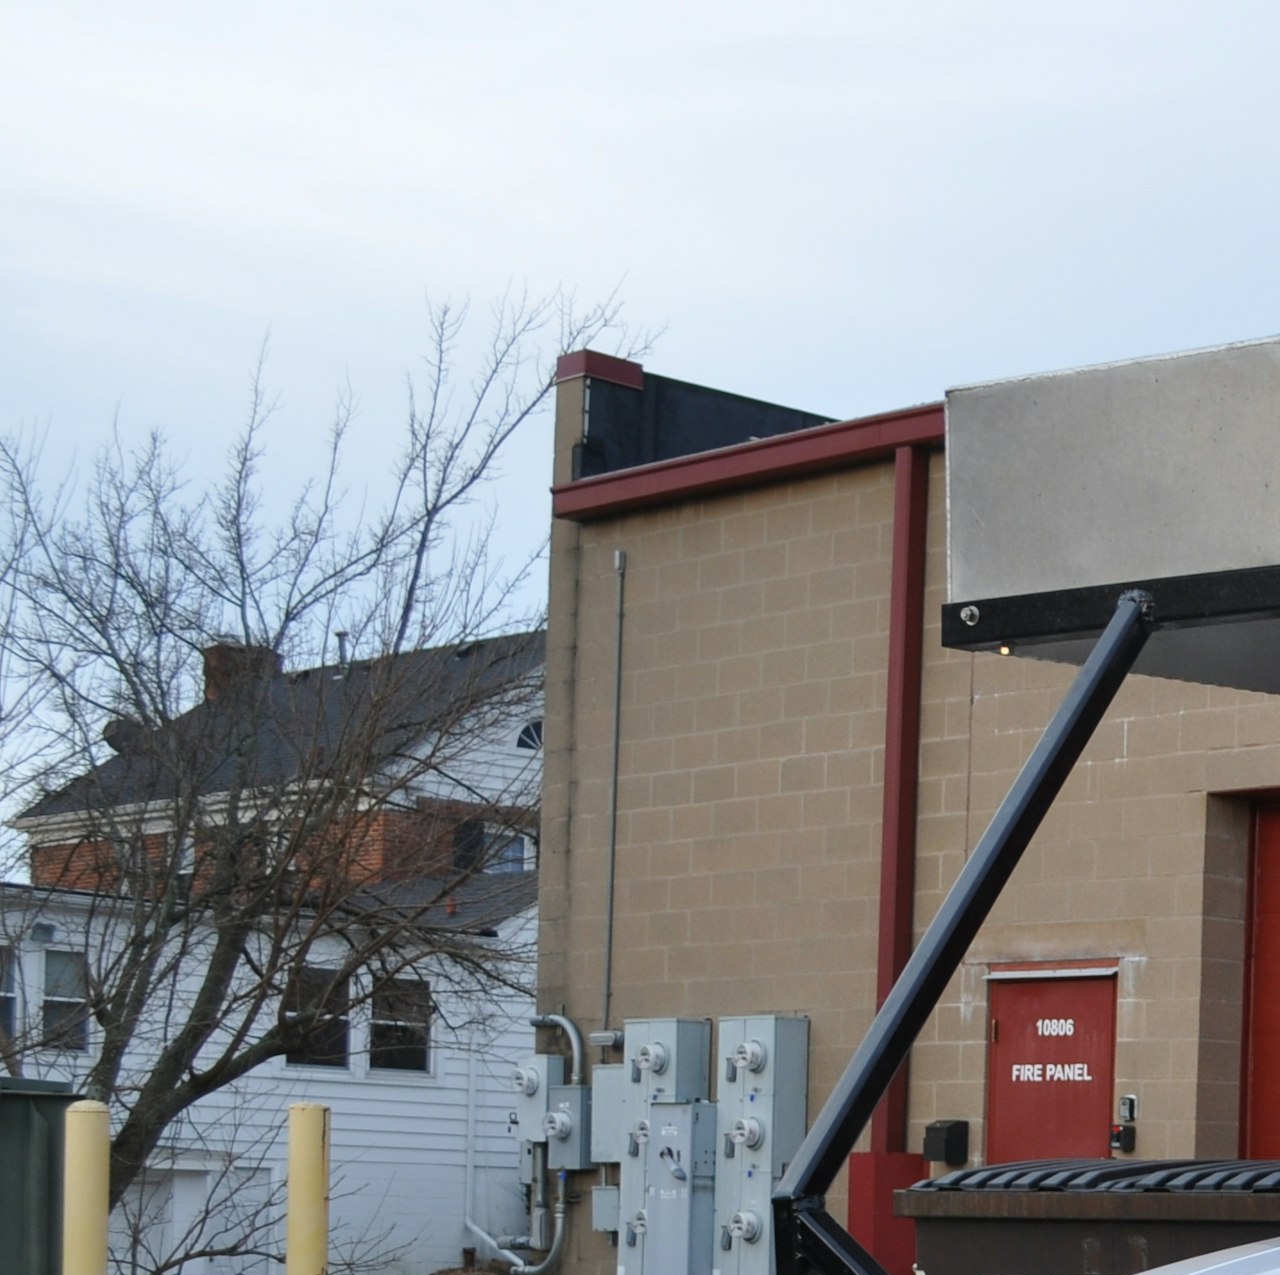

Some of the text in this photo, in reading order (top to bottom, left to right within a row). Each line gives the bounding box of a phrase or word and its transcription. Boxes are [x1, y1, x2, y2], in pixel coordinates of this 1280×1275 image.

[1036, 1018, 1075, 1037] 10806
[1012, 1063, 1093, 1082] FIRE PANEL
